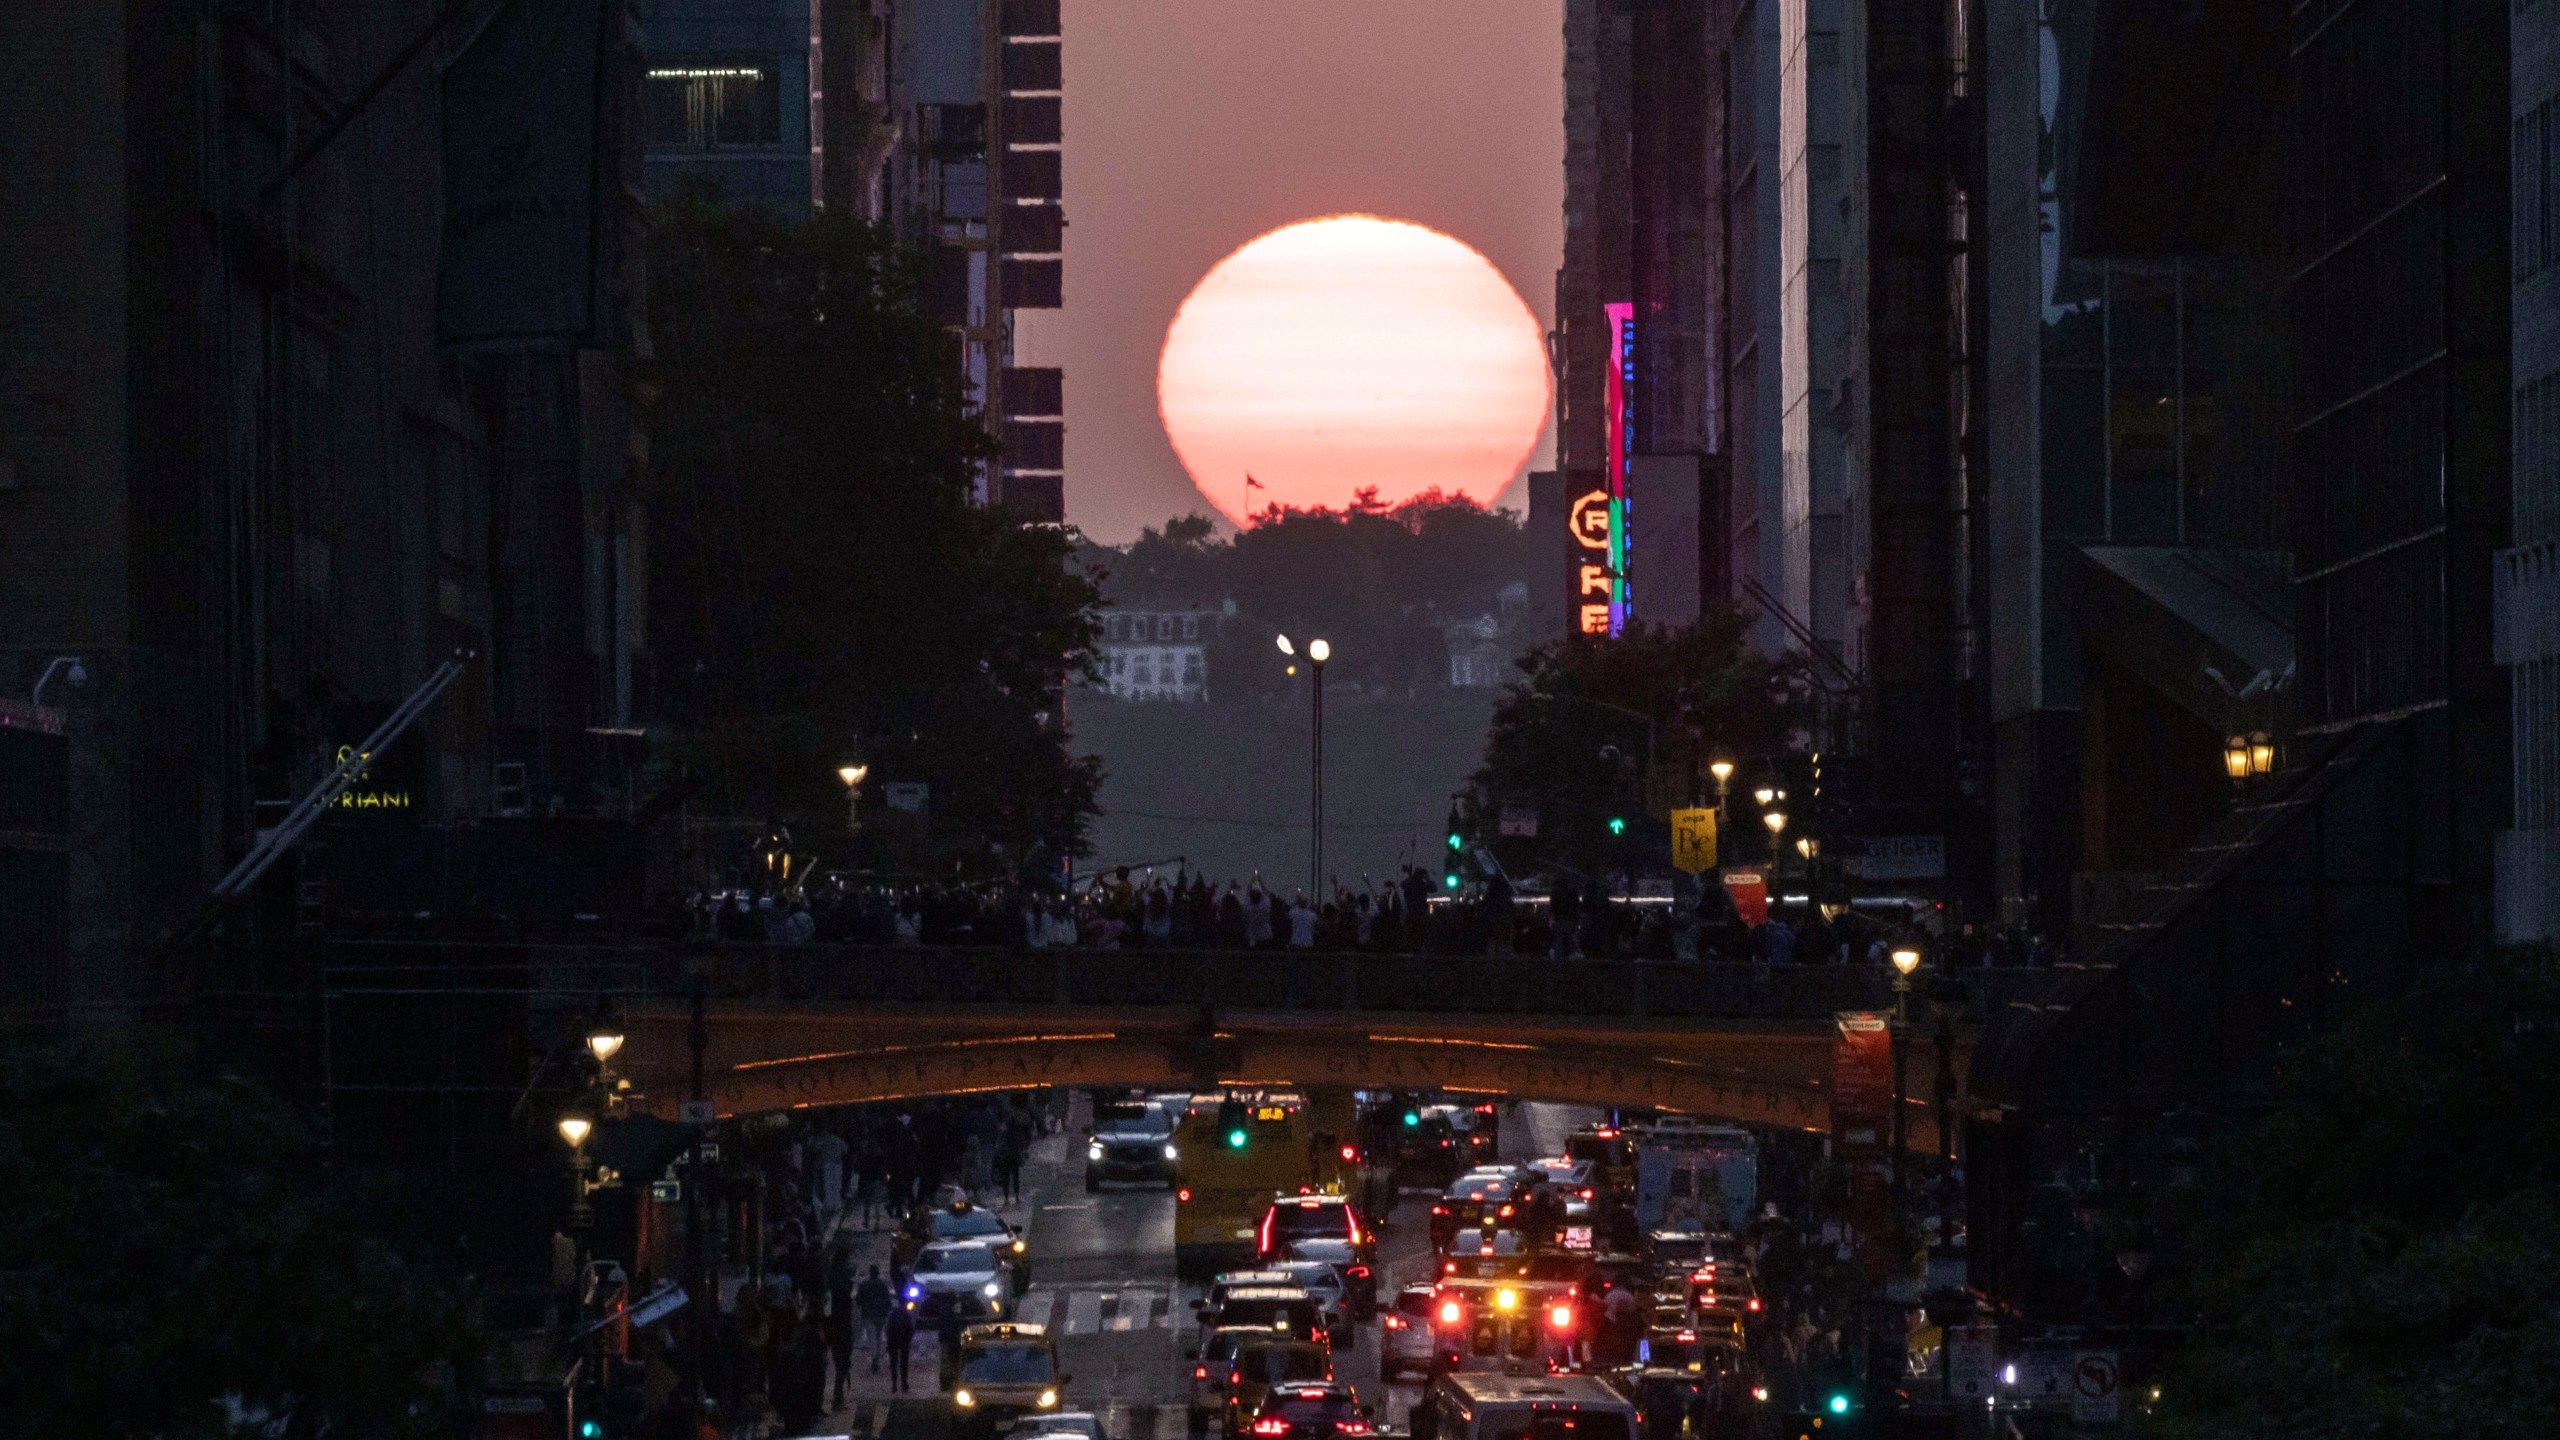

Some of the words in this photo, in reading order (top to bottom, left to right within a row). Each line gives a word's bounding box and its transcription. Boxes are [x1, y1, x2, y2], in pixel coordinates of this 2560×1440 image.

[313, 791, 410, 808] RIANI
[961, 1051, 1084, 1077] PLAZA
[1326, 1053, 1467, 1078] GRAND
